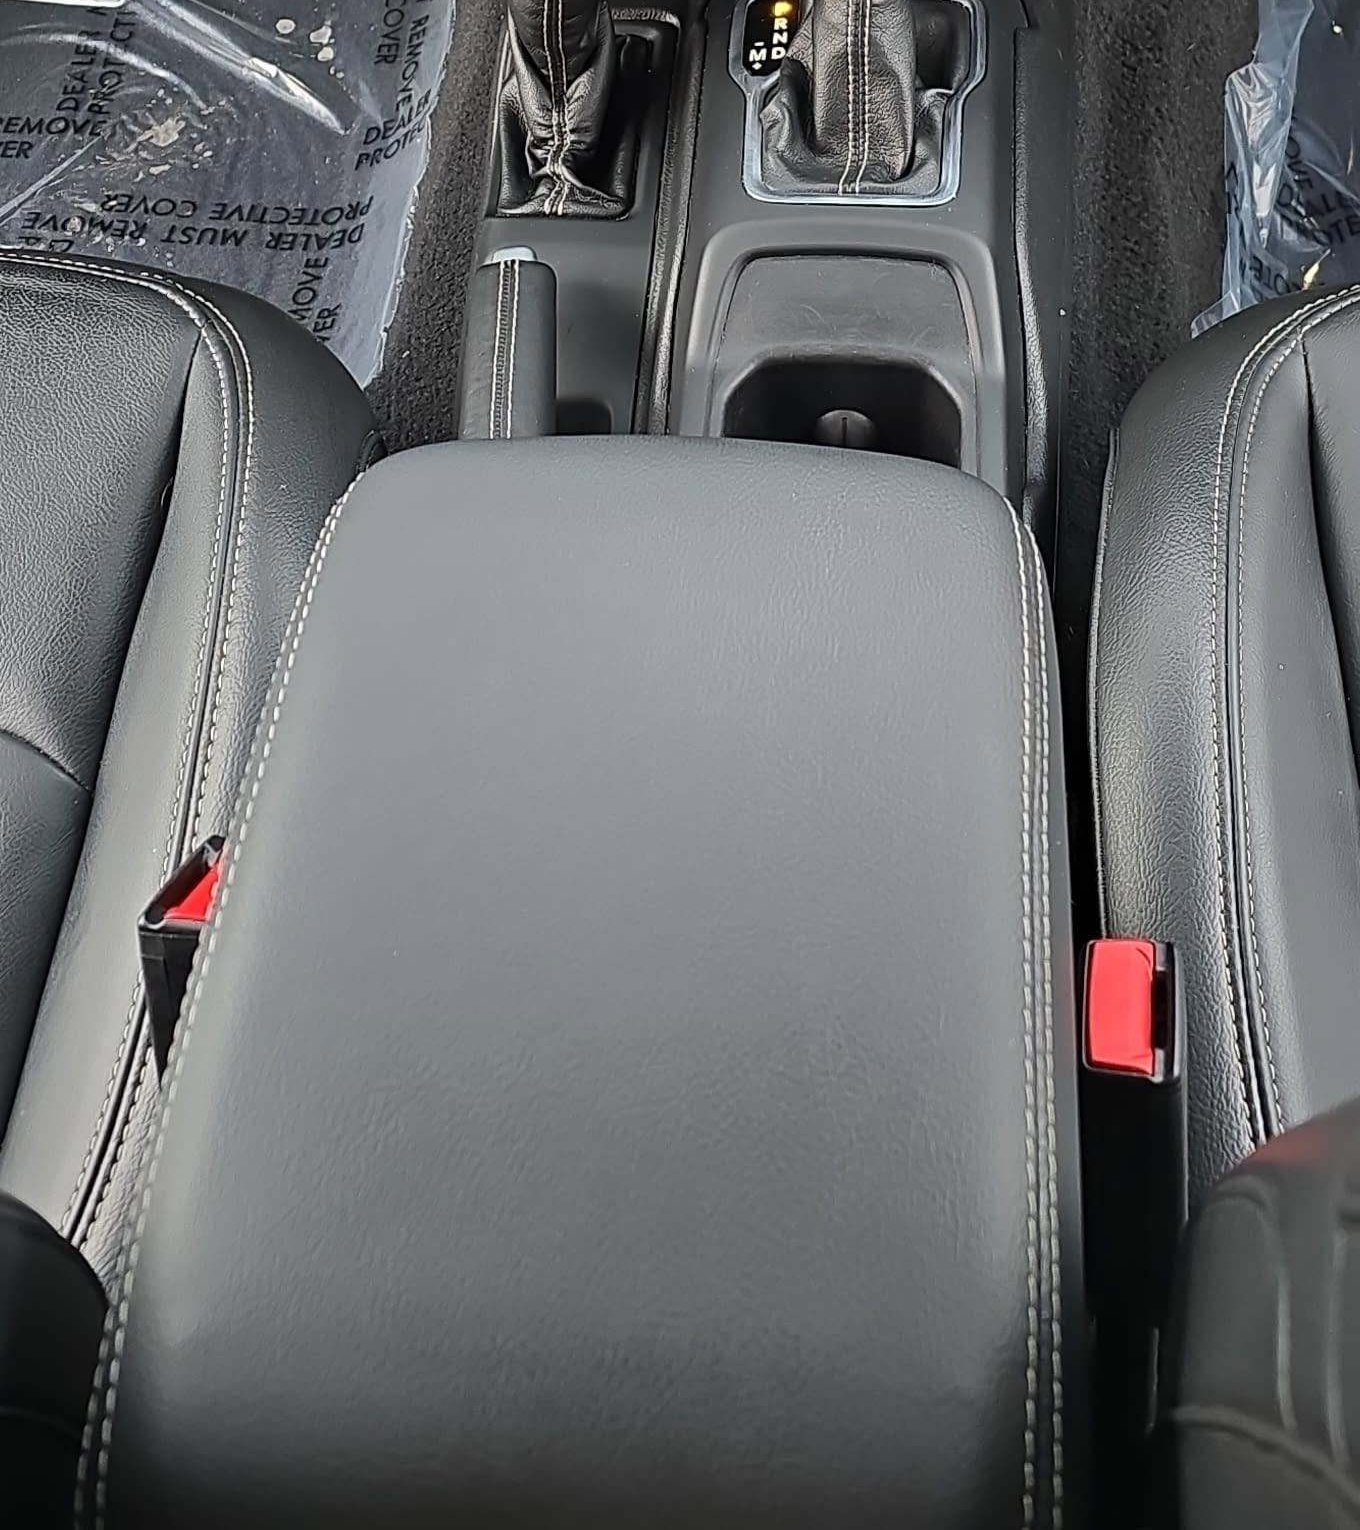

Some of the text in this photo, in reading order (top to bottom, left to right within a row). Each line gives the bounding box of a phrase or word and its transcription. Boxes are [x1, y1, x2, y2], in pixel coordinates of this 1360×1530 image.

[773, 17, 788, 30] R
[772, 31, 788, 45] N
[748, 48, 767, 62] M
[771, 48, 787, 60] D
[355, 120, 425, 171] PROTEC
[102, 192, 375, 227] PROTECTIVE COVER
[22, 210, 366, 253] DEALER MUST REMOVE
[290, 256, 329, 322] MOVE
